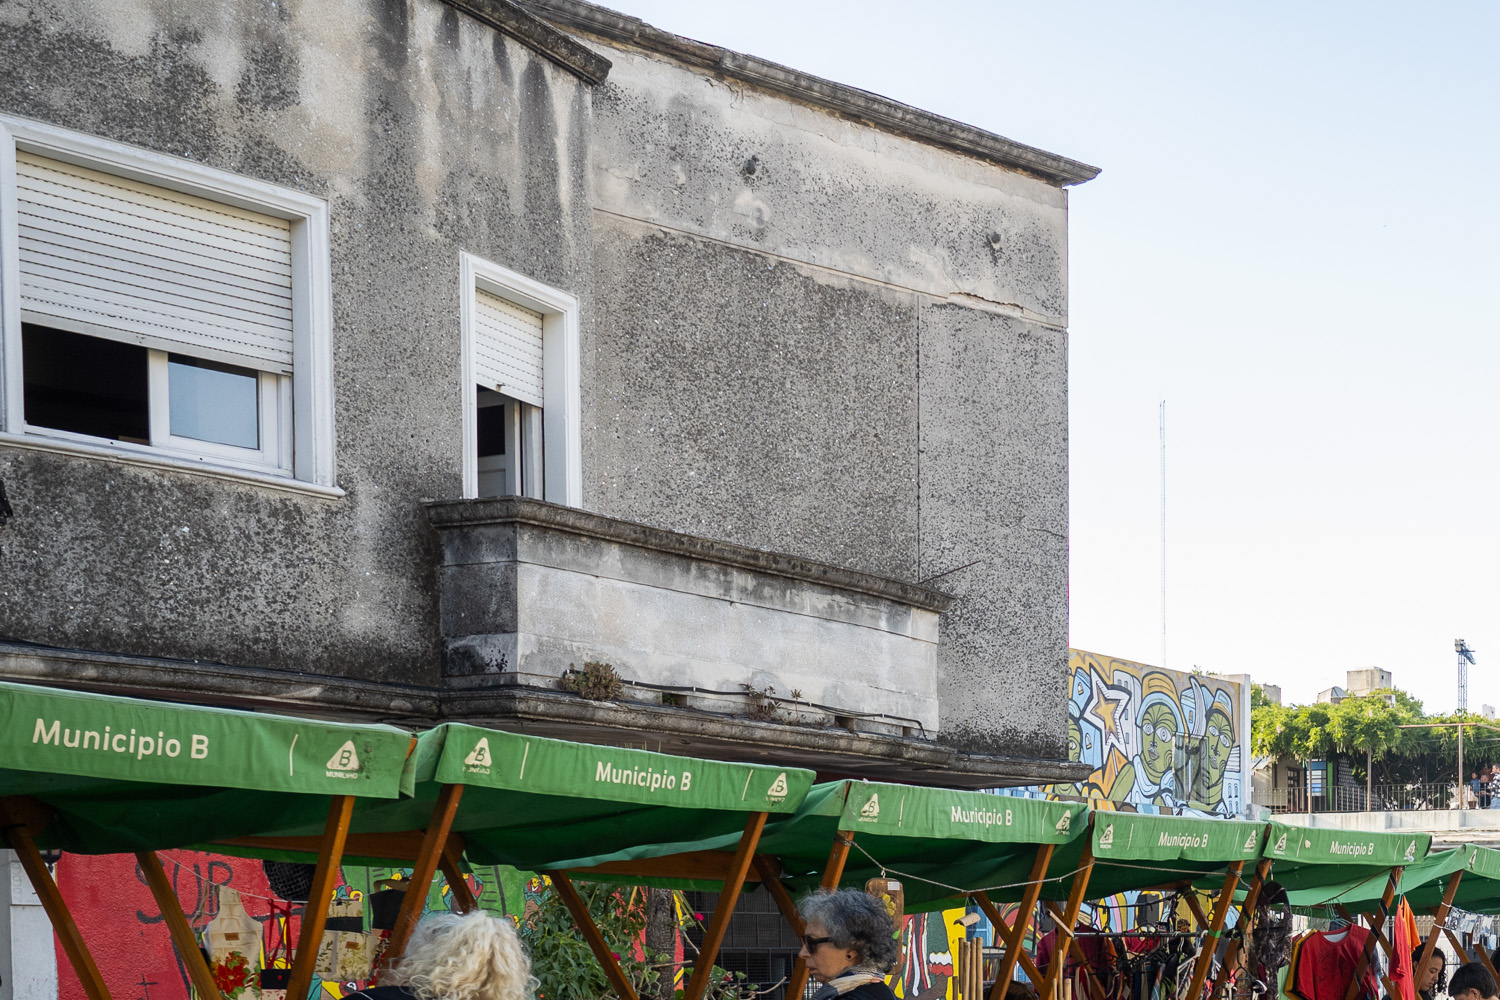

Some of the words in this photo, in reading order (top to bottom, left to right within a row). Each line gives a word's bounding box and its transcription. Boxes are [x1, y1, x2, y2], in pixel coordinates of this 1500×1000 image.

[32, 717, 182, 761] Municipio
[190, 734, 210, 760] B
[594, 761, 676, 792] Municipio
[680, 771, 692, 791] B
[951, 805, 1003, 829] Municipio
[1005, 809, 1013, 826] B
[1158, 831, 1200, 850] Municipio
[1200, 833, 1209, 848] B
[1329, 840, 1367, 858] Municipio
[1367, 844, 1374, 856] B
